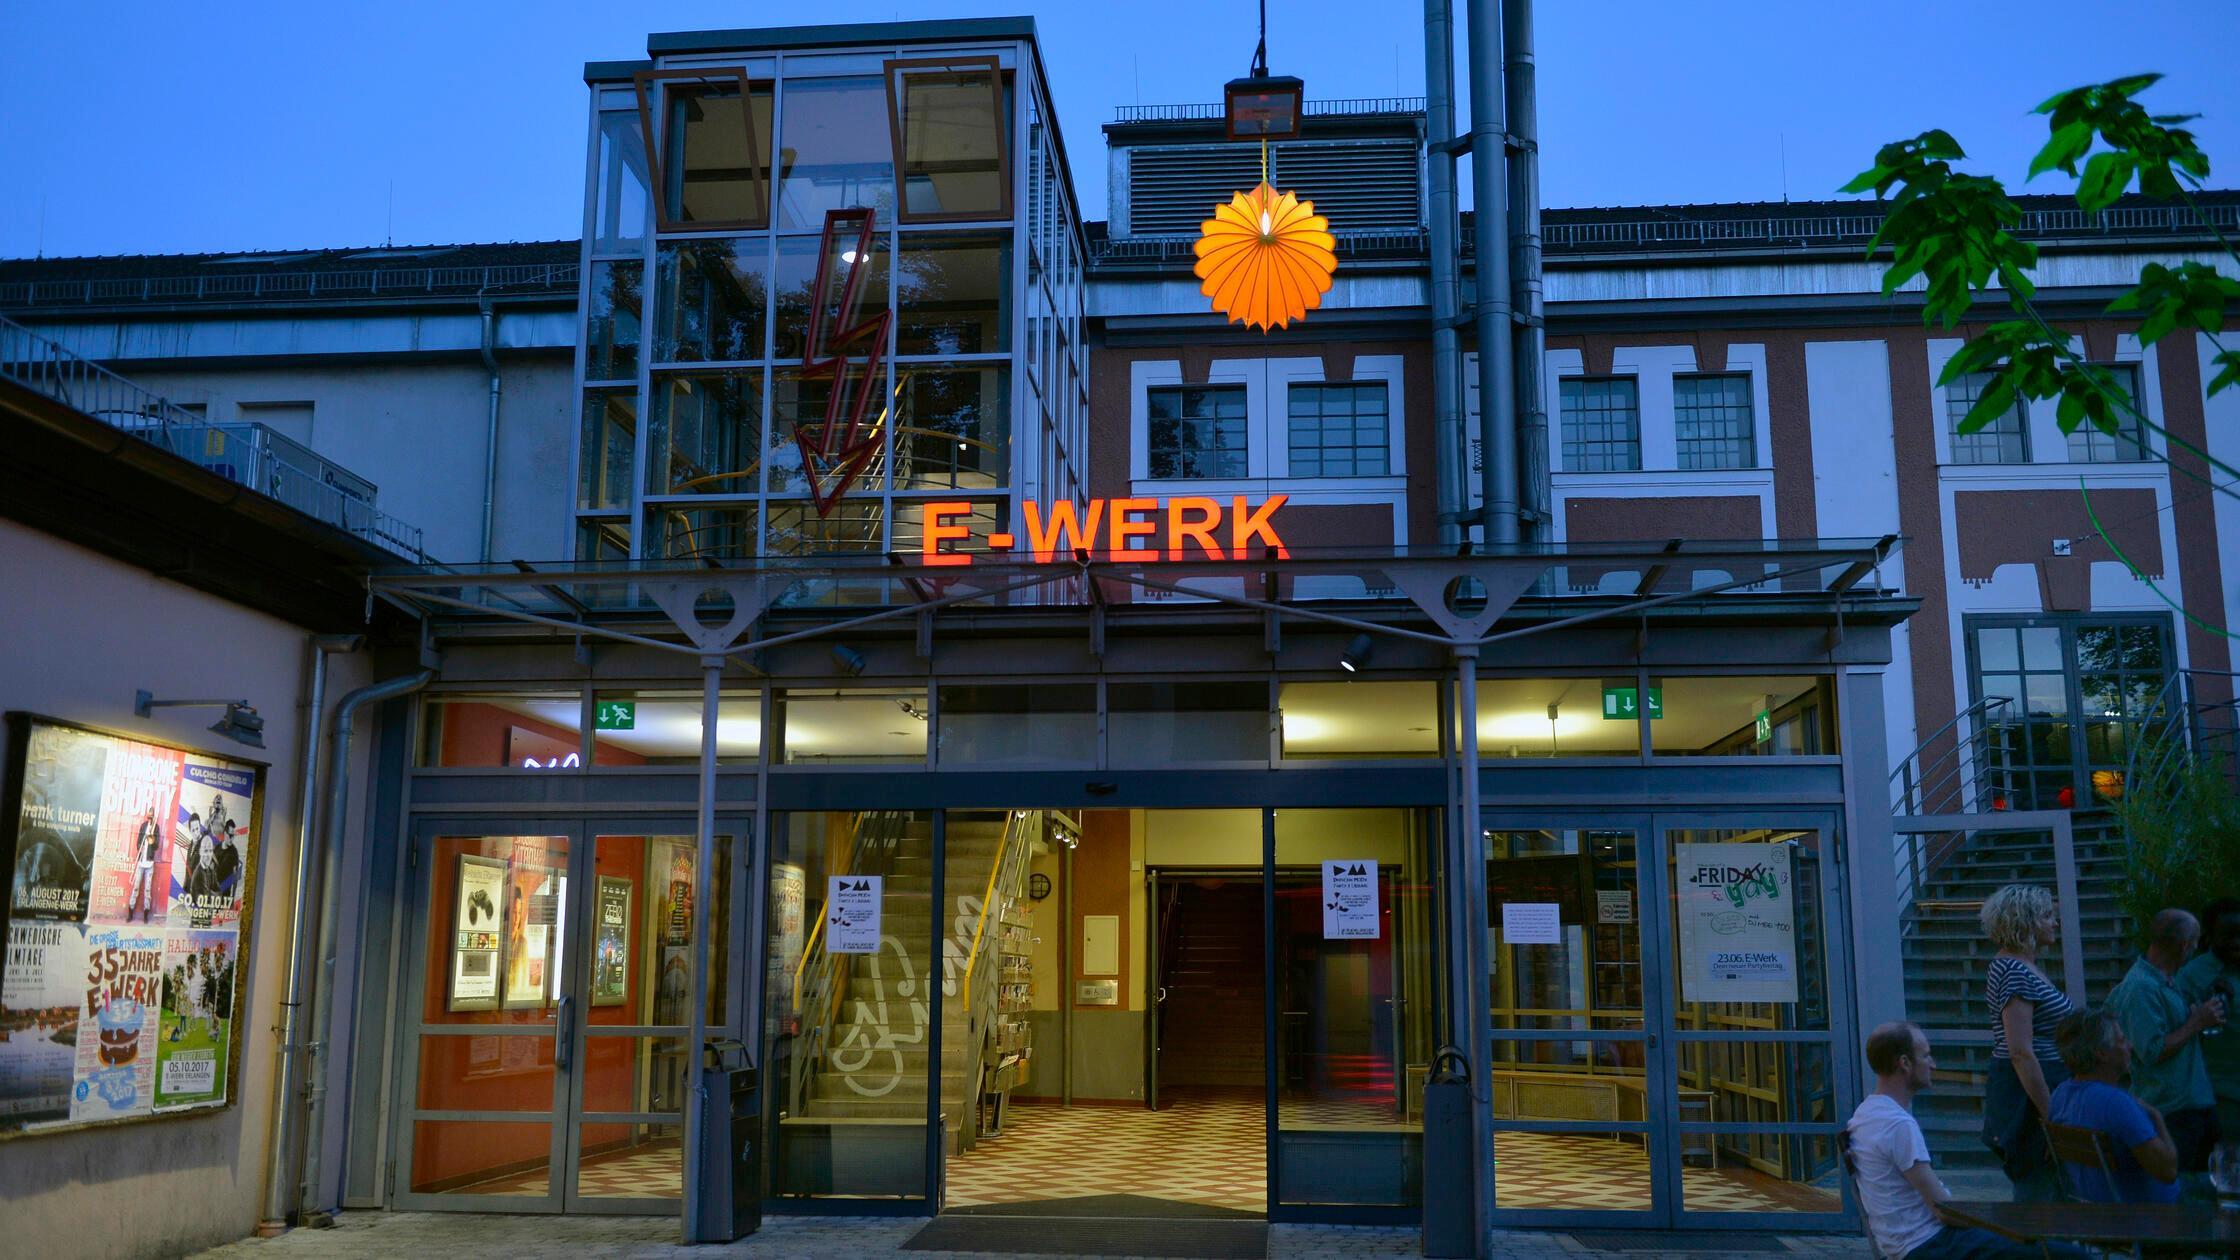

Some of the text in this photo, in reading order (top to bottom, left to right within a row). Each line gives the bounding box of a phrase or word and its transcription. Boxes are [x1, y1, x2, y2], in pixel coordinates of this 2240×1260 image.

[922, 495, 1291, 566] E-WERK
[104, 780, 176, 819] SHORTY
[58, 806, 96, 827] turner
[31, 887, 62, 900] AUGUST
[63, 889, 80, 901] 2017
[178, 893, 233, 908] SO. 01.10.17
[167, 939, 200, 953] HALLO
[1717, 952, 1777, 963] 23.06. E-Werk
[88, 947, 161, 985] 35 JAHRE
[169, 1061, 209, 1072] 05.10.2017
